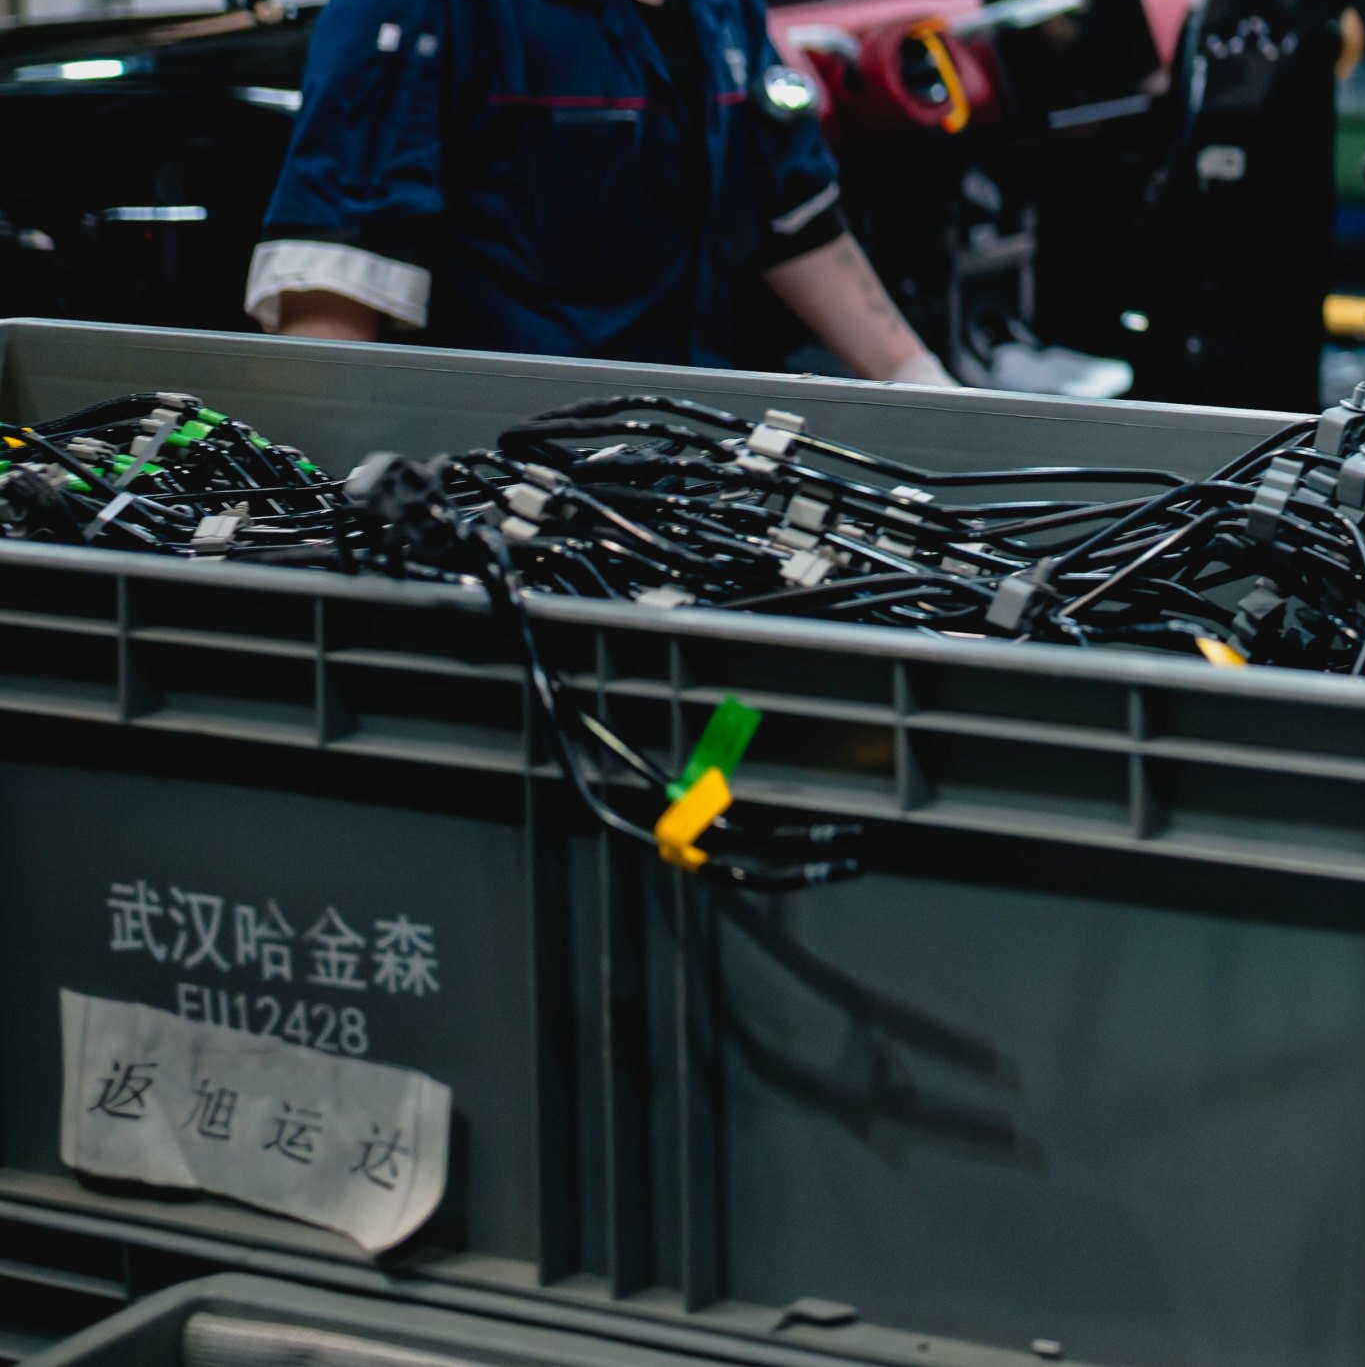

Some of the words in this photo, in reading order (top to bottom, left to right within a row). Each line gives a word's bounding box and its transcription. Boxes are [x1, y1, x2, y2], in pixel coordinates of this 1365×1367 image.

[107, 880, 439, 997] 武汉哈金森
[88, 1060, 411, 1191] 返旭运达
